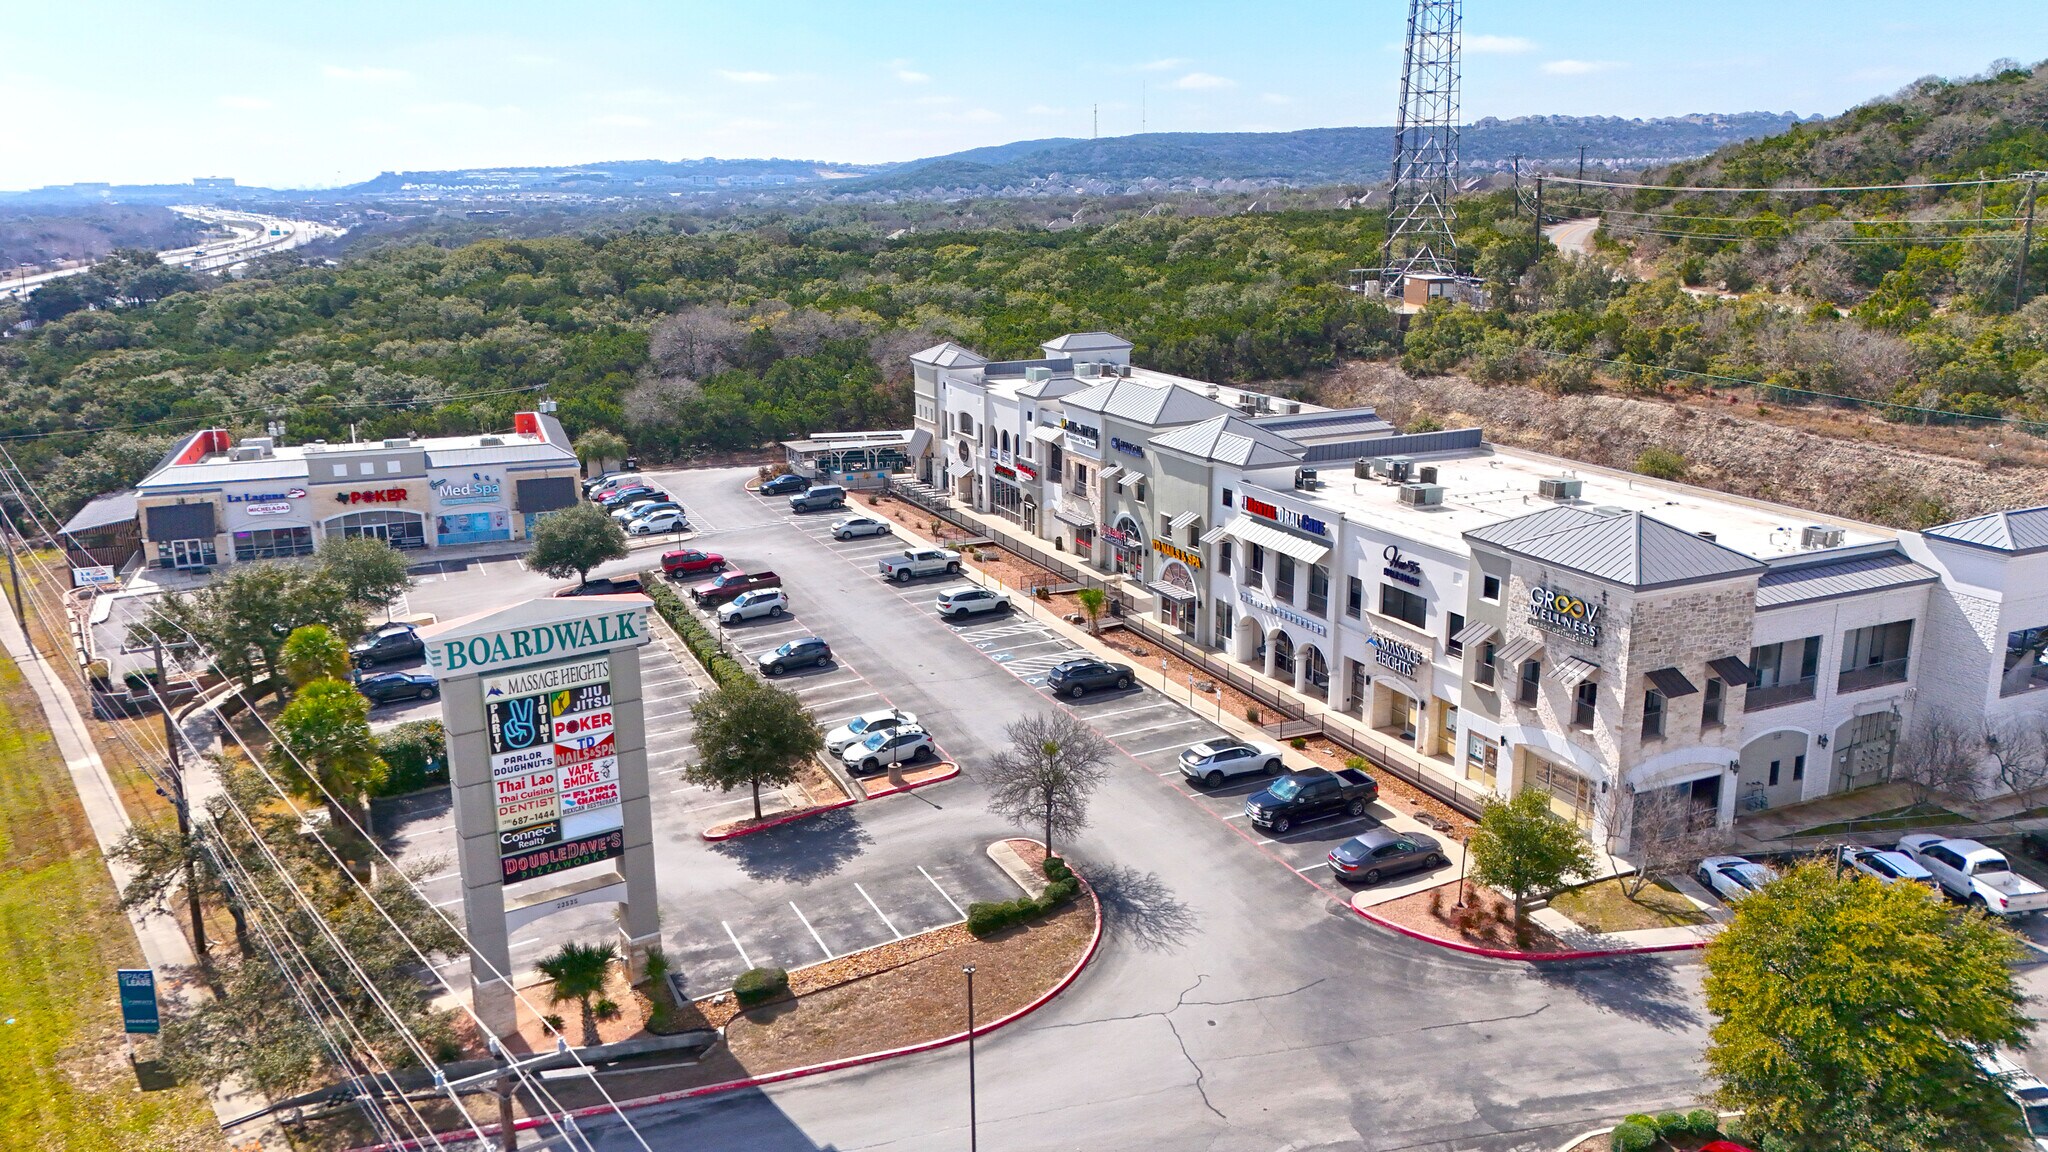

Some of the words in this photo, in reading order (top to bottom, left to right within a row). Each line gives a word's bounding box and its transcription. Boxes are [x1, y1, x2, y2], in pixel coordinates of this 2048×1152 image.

[227, 494, 241, 503] La
[440, 484, 471, 497] Med
[474, 483, 500, 496] Spa
[248, 505, 289, 513] MICHELADAS
[1278, 507, 1300, 529] ORAL
[1161, 541, 1180, 560] NAILS
[1187, 554, 1202, 568] SPA
[1530, 604, 1598, 637] WELLNESS
[444, 612, 638, 670] BOARDWALK
[1529, 619, 1551, 631] ENERGY
[1552, 627, 1594, 646] OPTIMIZATION
[1381, 637, 1422, 666] MASSAGE
[1376, 649, 1413, 676] HEIGHTS
[508, 670, 559, 695] MASSAGE
[560, 661, 609, 684] HEIGHTS
[580, 685, 602, 699] JIU
[573, 694, 611, 712] JITSU
[537, 694, 550, 743] JOINT
[490, 704, 502, 753] PARTY
[577, 736, 595, 750] TD
[494, 758, 553, 776] DOUGHNUTS
[504, 752, 542, 765] PARLOR
[568, 762, 594, 776] VAPE
[497, 777, 525, 794] Thai
[531, 774, 554, 789] Lao
[563, 771, 600, 789] SMOKE
[499, 793, 518, 804] Thai
[520, 788, 555, 800] Cuisine
[573, 783, 617, 799] FLYING
[577, 791, 618, 805] CHANCLA
[499, 797, 555, 816] DENTIST
[562, 804, 585, 816] MEXICAN
[587, 797, 619, 809] RESTAURANT
[512, 810, 555, 826] 687-1444
[501, 823, 557, 844] Connect
[518, 837, 546, 849] Realty
[505, 832, 622, 875] DOUBLEDAVE'S
[521, 851, 608, 879] PIZZAWORKS
